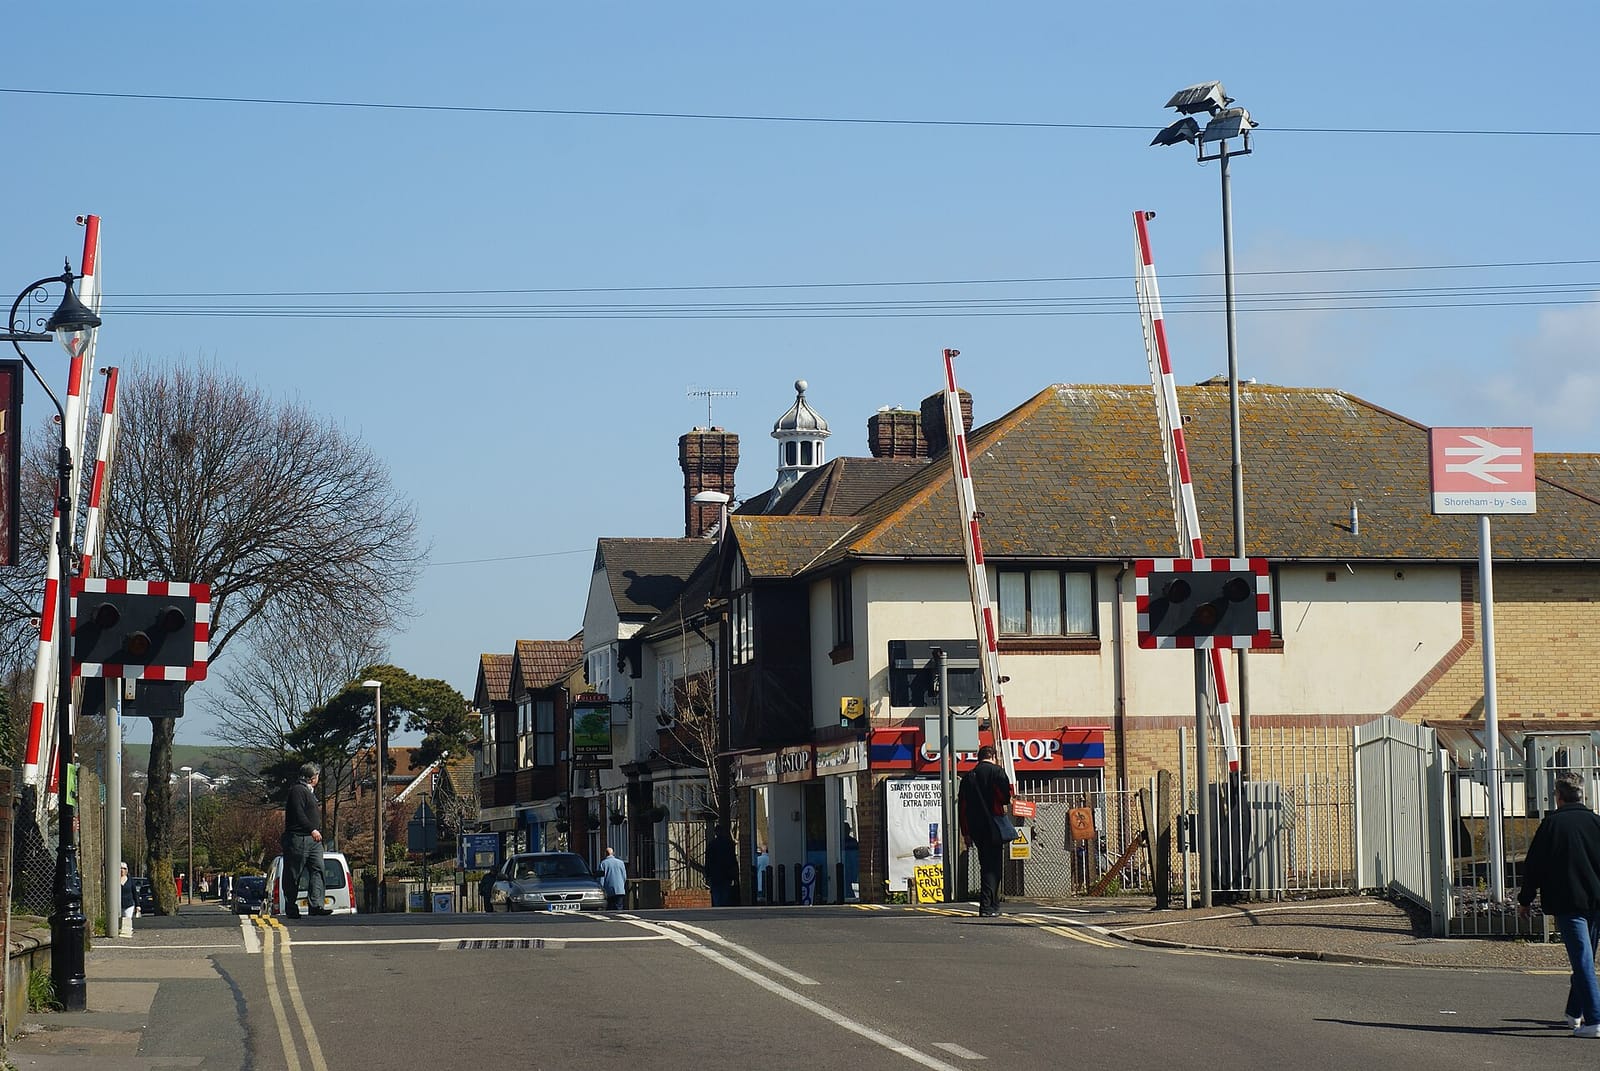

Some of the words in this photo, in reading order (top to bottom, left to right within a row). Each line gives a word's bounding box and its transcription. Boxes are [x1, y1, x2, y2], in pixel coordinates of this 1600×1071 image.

[1010, 739, 1060, 761] TOP
[890, 783, 911, 791] STARTS
[912, 783, 930, 791] YOUR
[899, 791, 913, 799] AND
[914, 791, 931, 799] GIVES
[932, 791, 942, 799] YO
[903, 799, 922, 807] EXTRA
